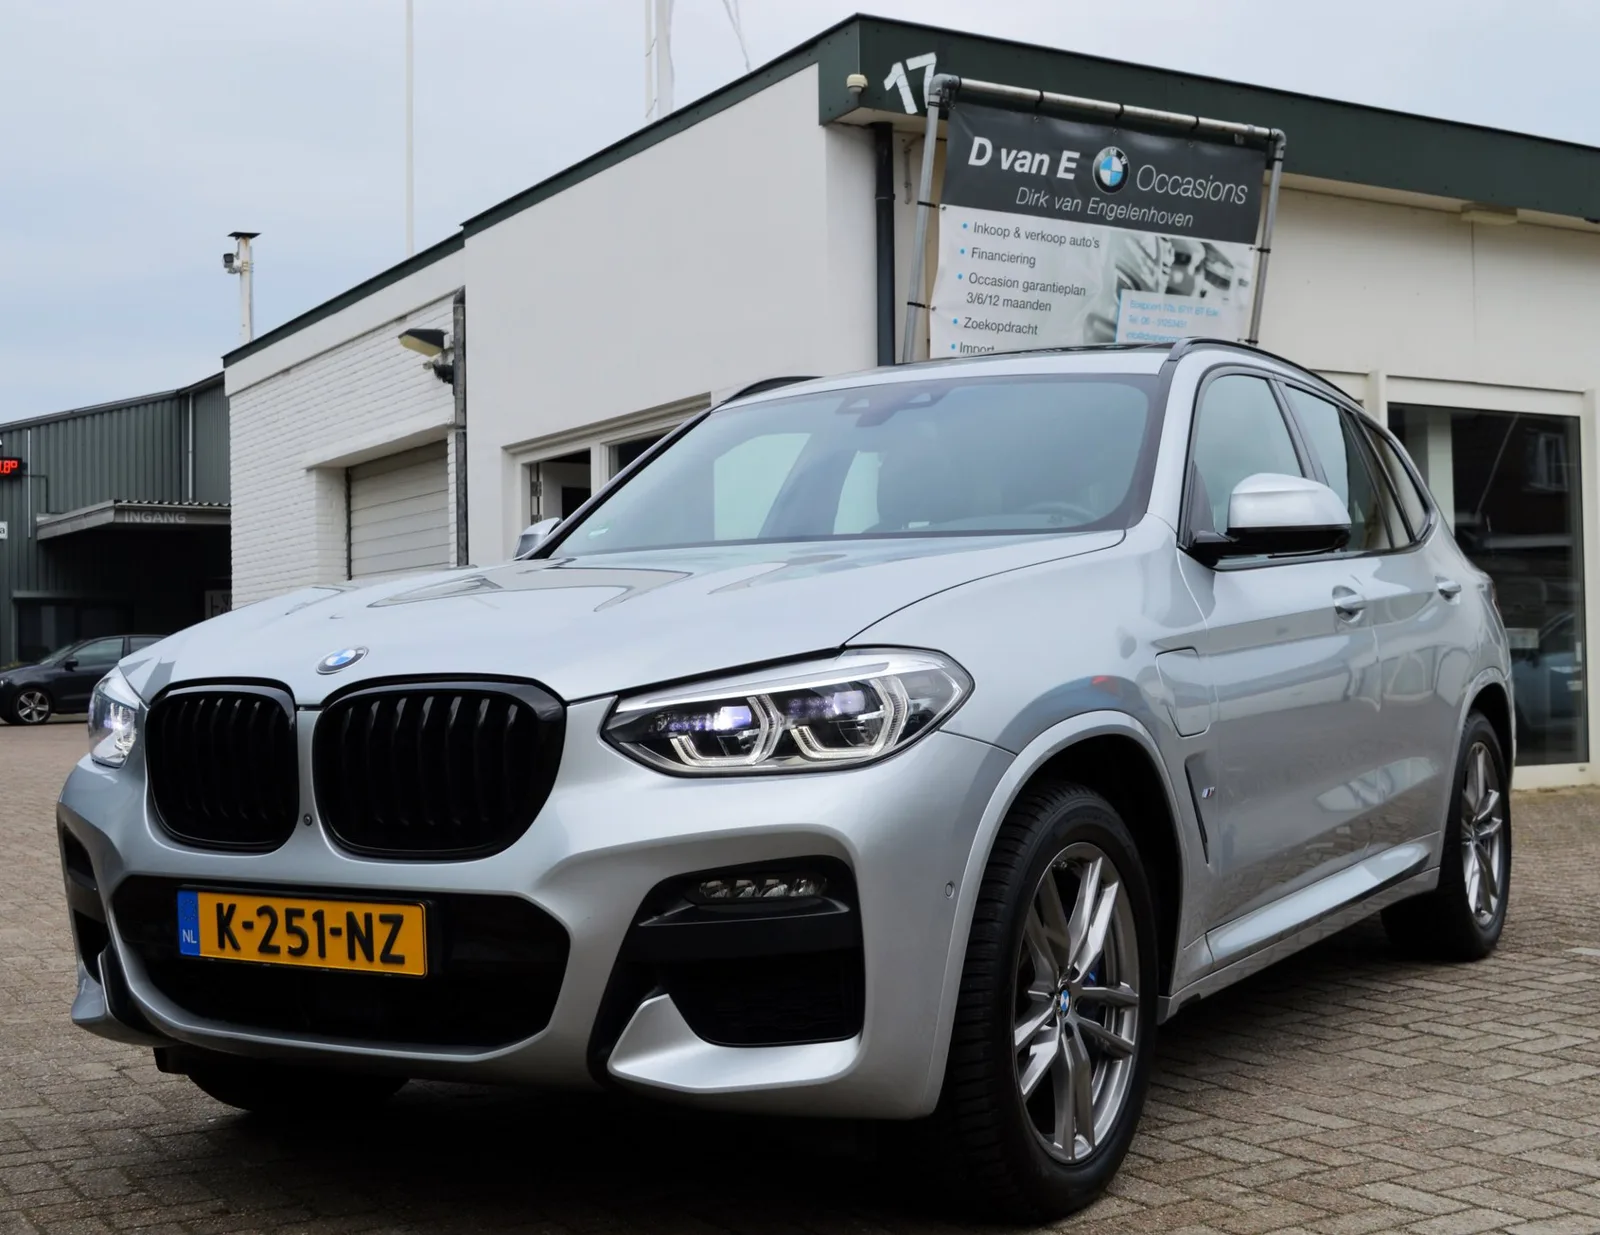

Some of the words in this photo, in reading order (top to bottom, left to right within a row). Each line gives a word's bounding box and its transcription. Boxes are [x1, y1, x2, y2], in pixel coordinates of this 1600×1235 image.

[883, 52, 937, 114] 17
[967, 136, 993, 167] D
[1000, 147, 1050, 176] van
[1056, 150, 1080, 180] E
[1136, 164, 1248, 204] Occasions
[1016, 187, 1049, 208] Dirk
[1054, 196, 1082, 212] van
[1087, 197, 1193, 227] Engelenhoven
[973, 221, 1011, 239] Inkoop
[1013, 227, 1021, 239] &
[1025, 230, 1066, 247] verkoop
[1069, 236, 1100, 249] auto's
[971, 247, 1036, 269] Financiering
[968, 272, 1019, 289] Occasion
[1022, 279, 1086, 297] garantieplan
[966, 292, 1000, 307] 3/6/12
[1002, 297, 1052, 312] maanden
[963, 316, 1038, 336] Zoekopdracht
[124, 509, 187, 523] INGANG
[182, 929, 198, 945] NL
[215, 902, 406, 965] K-251-NZ
